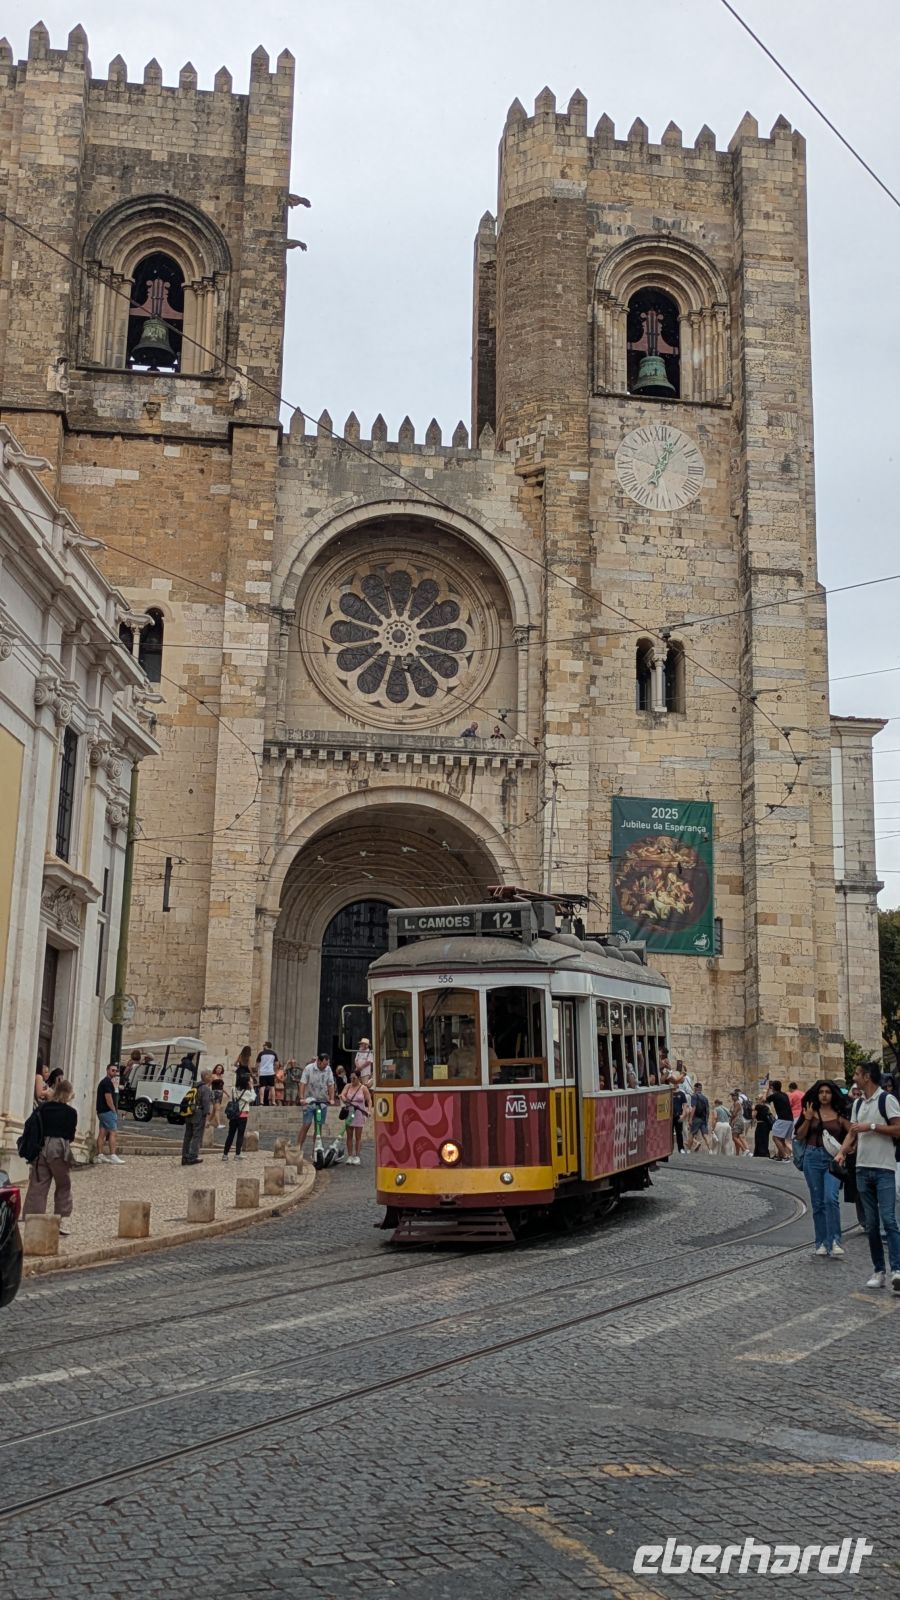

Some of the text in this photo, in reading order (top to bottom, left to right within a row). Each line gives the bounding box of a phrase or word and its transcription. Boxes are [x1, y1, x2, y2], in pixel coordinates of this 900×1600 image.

[688, 465, 704, 475] III
[651, 807, 679, 819] 2025
[621, 820, 707, 834] Jubileu da Esperança
[404, 919, 415, 929] L.
[492, 912, 513, 929] 12
[438, 975, 454, 984] 556
[505, 1100, 546, 1113] MB WAY
